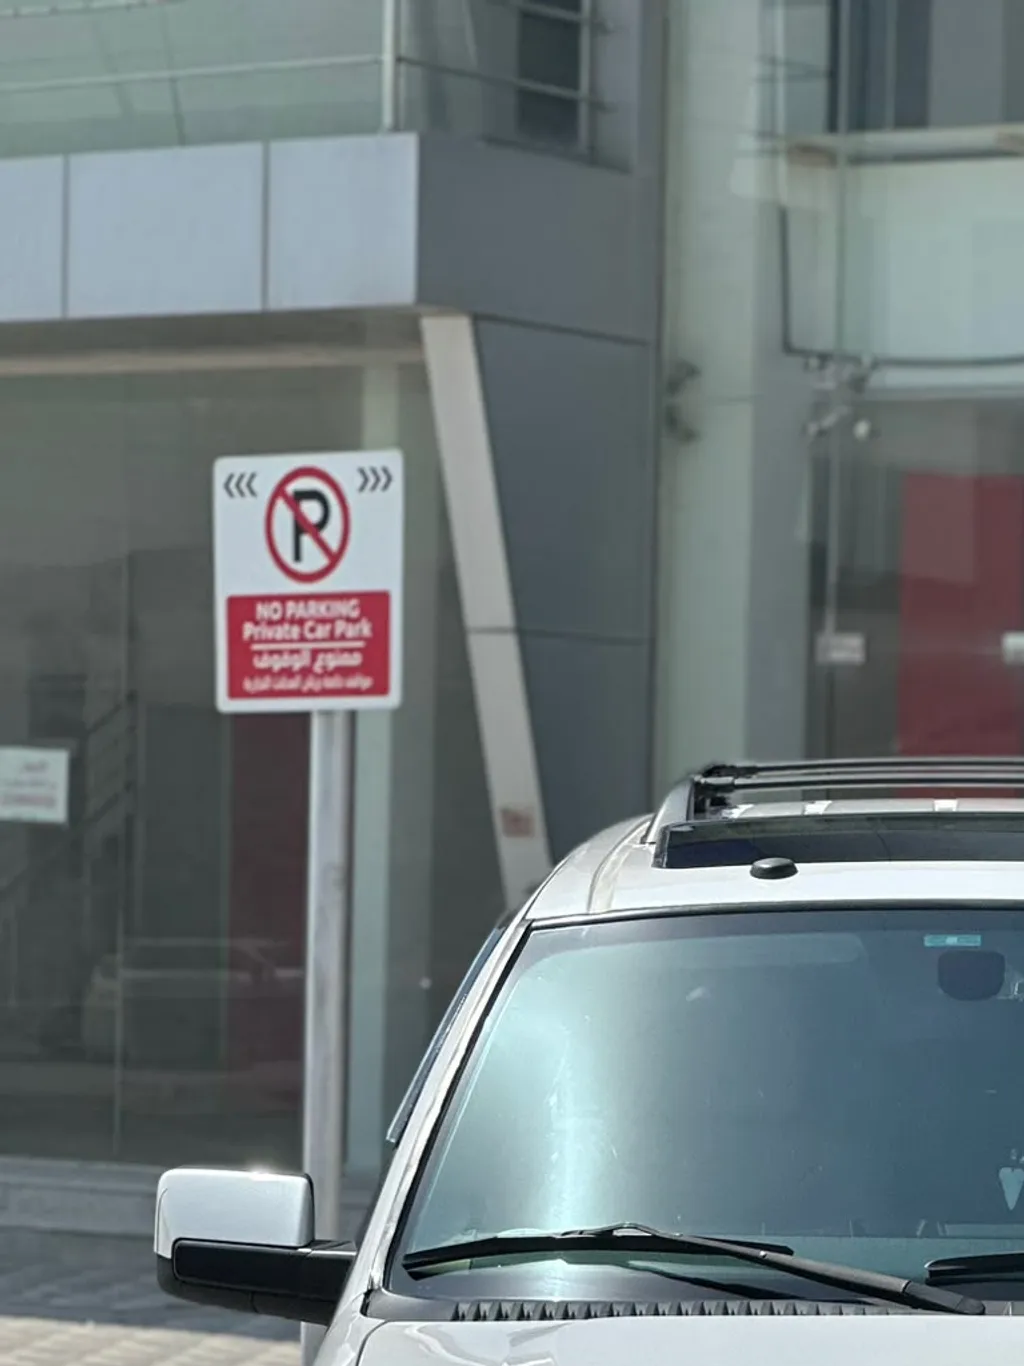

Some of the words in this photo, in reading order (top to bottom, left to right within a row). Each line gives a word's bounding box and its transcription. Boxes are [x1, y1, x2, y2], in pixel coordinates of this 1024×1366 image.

[255, 600, 283, 620] NO
[285, 598, 361, 619] PARKING
[242, 620, 301, 641] Private
[303, 619, 332, 639] Car
[333, 617, 373, 638] Park
